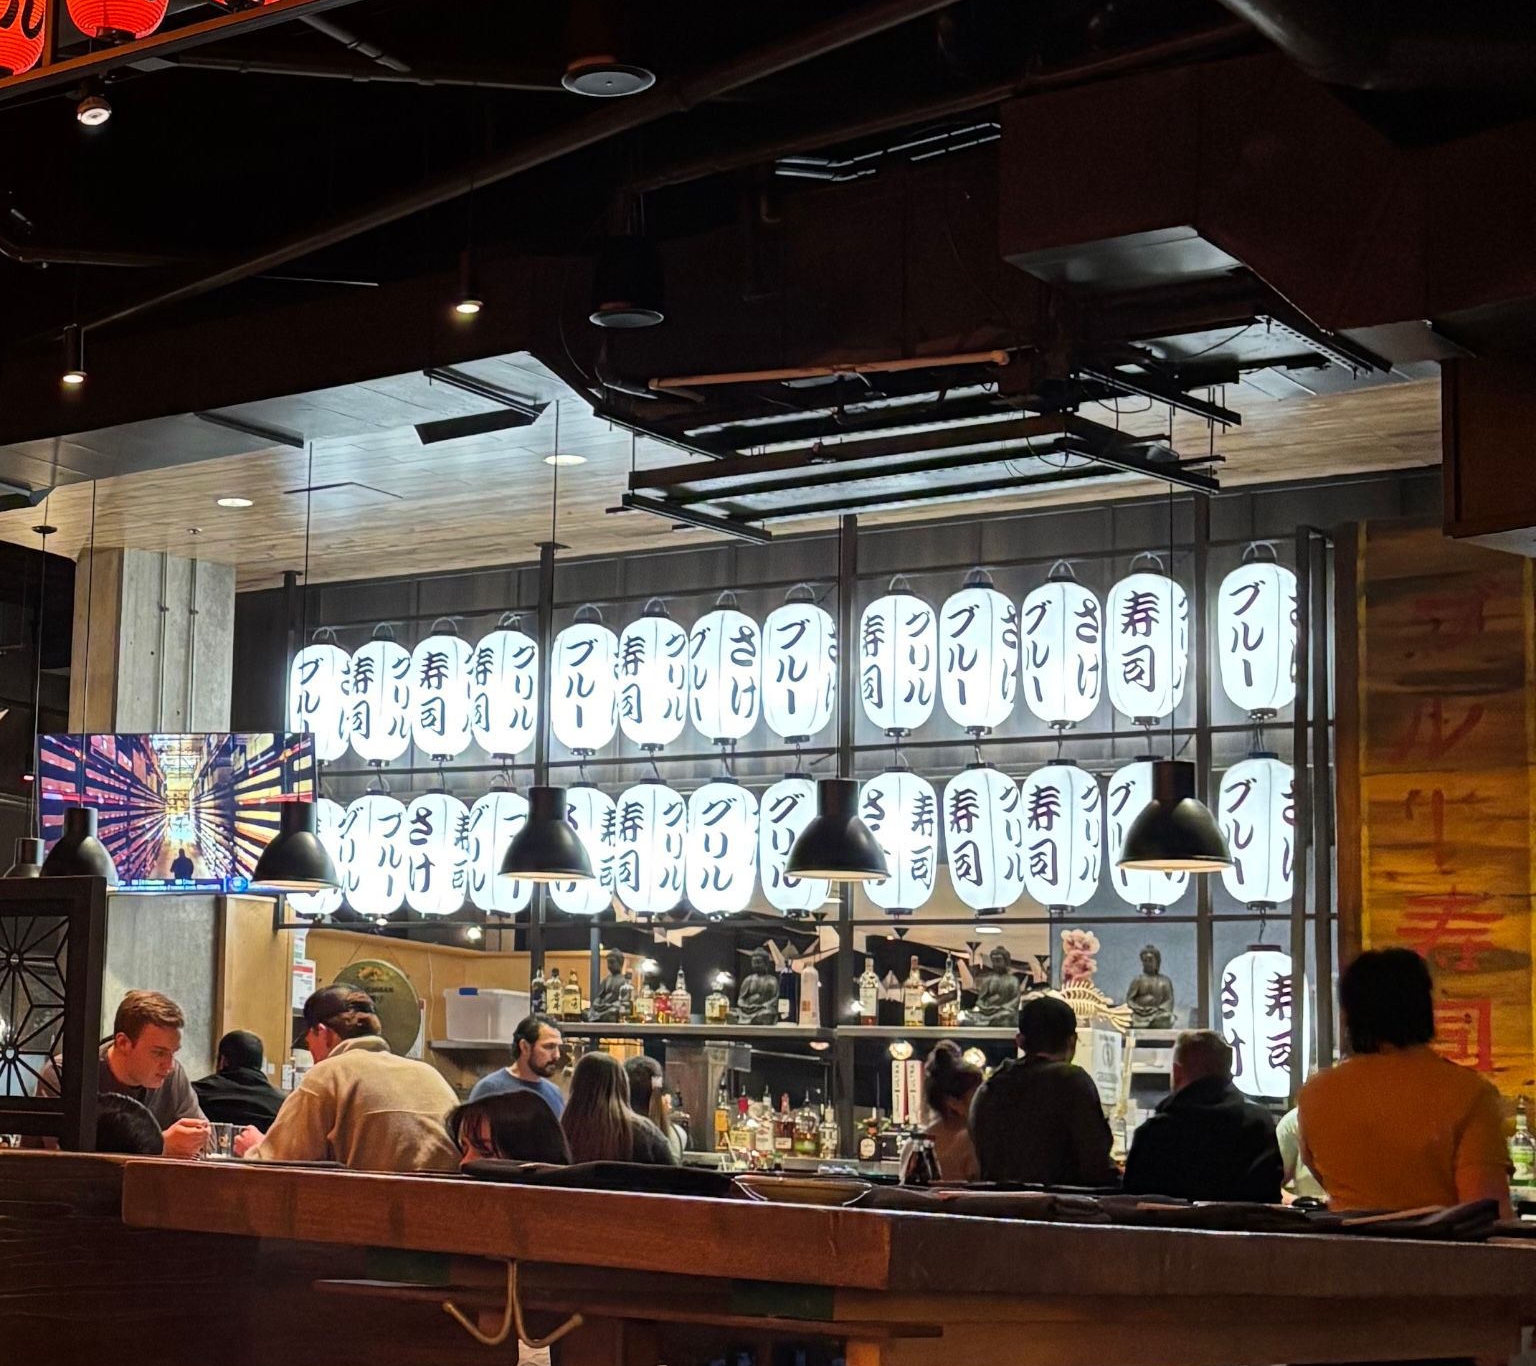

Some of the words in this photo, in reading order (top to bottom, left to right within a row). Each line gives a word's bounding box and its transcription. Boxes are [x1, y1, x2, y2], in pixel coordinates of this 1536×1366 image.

[621, 636, 645, 723] 寿司
[663, 633, 686, 722] グリル
[730, 625, 757, 719] さけ
[776, 618, 810, 715] ブルー
[863, 614, 885, 709] 寿司
[904, 610, 930, 706] グリル
[947, 603, 979, 705] ブルー
[1024, 599, 1052, 702] ブルー
[1074, 597, 1100, 700] さけ
[1121, 590, 1159, 692] 寿司
[1229, 580, 1266, 687] ブルー
[352, 656, 374, 740] 寿司
[388, 656, 411, 739] グリル
[419, 651, 449, 735] 寿司
[467, 647, 494, 732] 寿司
[511, 646, 536, 731] グリル
[566, 639, 598, 728] ブルー
[378, 813, 403, 897] ブルー
[409, 807, 436, 893] さけ
[620, 801, 644, 892] 寿司
[659, 801, 684, 891] グリル
[701, 798, 736, 891] グリル
[910, 790, 936, 890] 寿司
[949, 788, 980, 886] 寿司
[999, 786, 1023, 883] グリル
[1026, 785, 1061, 886] 寿司
[1223, 777, 1258, 885] ブルー
